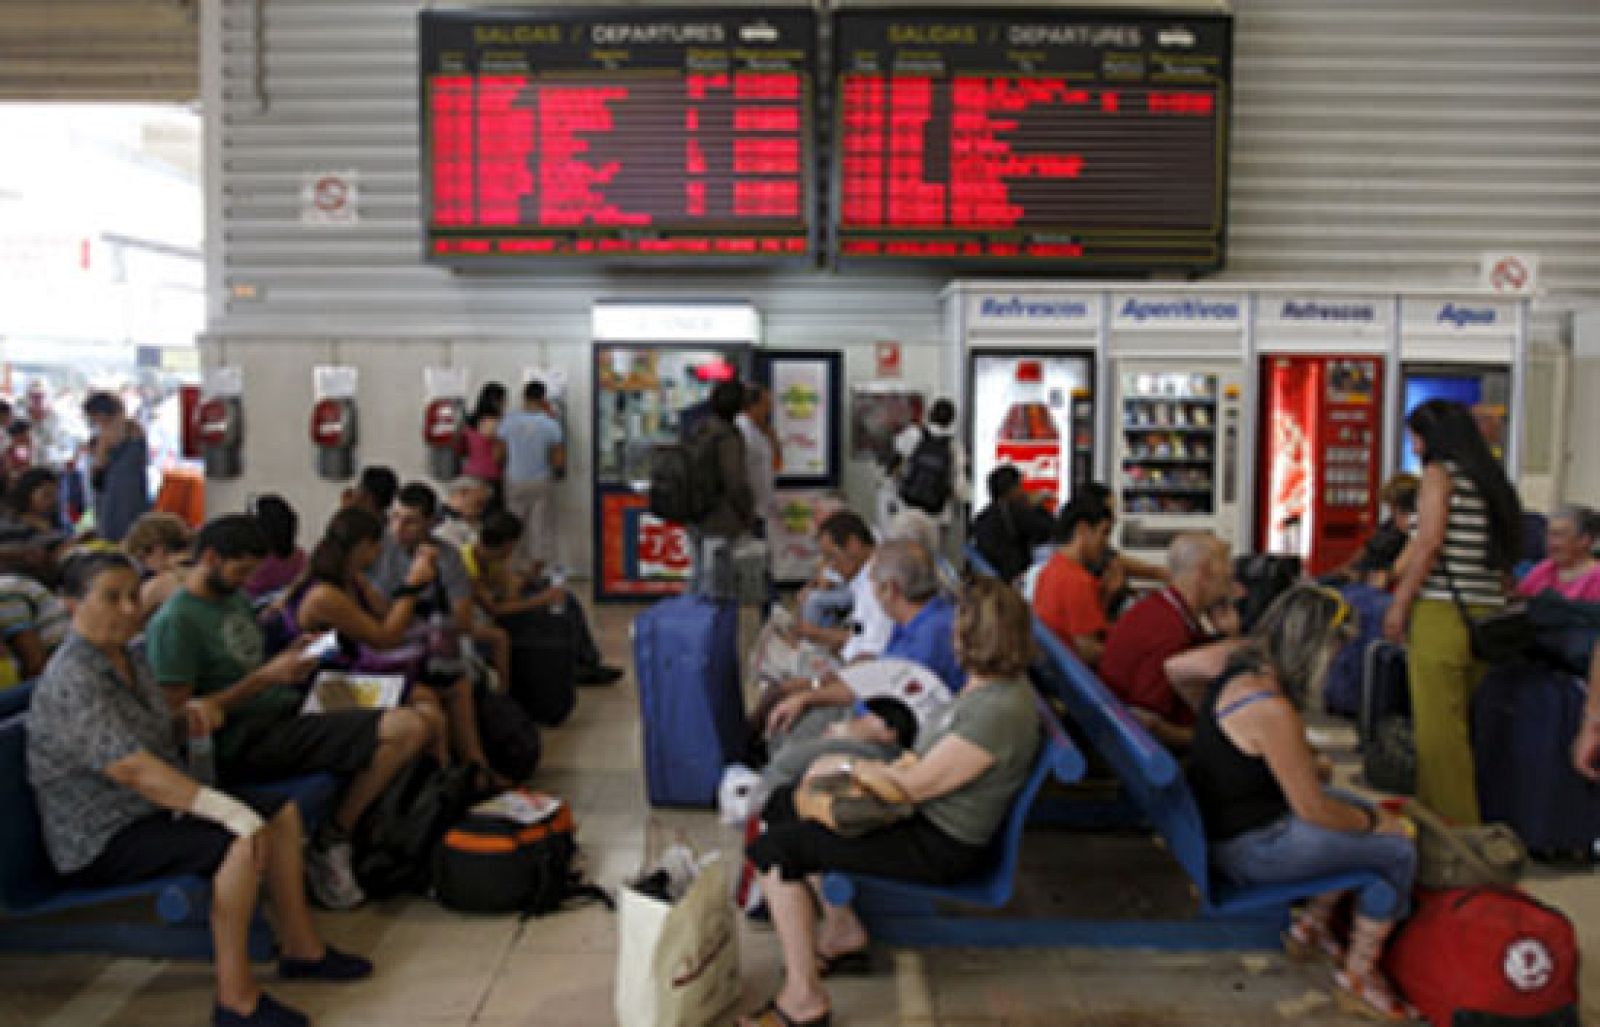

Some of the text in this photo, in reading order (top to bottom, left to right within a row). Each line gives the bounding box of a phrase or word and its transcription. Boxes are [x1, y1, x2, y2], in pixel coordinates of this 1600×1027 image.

[474, 25, 561, 43] SALIDAS
[591, 24, 725, 44] DEPARTURES
[887, 25, 977, 44] SALIDAS
[1008, 26, 1141, 46] DEPARTURES
[981, 297, 1087, 317] Refrescos
[1121, 298, 1239, 321] Aperitivos
[1280, 301, 1374, 321] Refrescos
[1436, 302, 1496, 327] Agua
